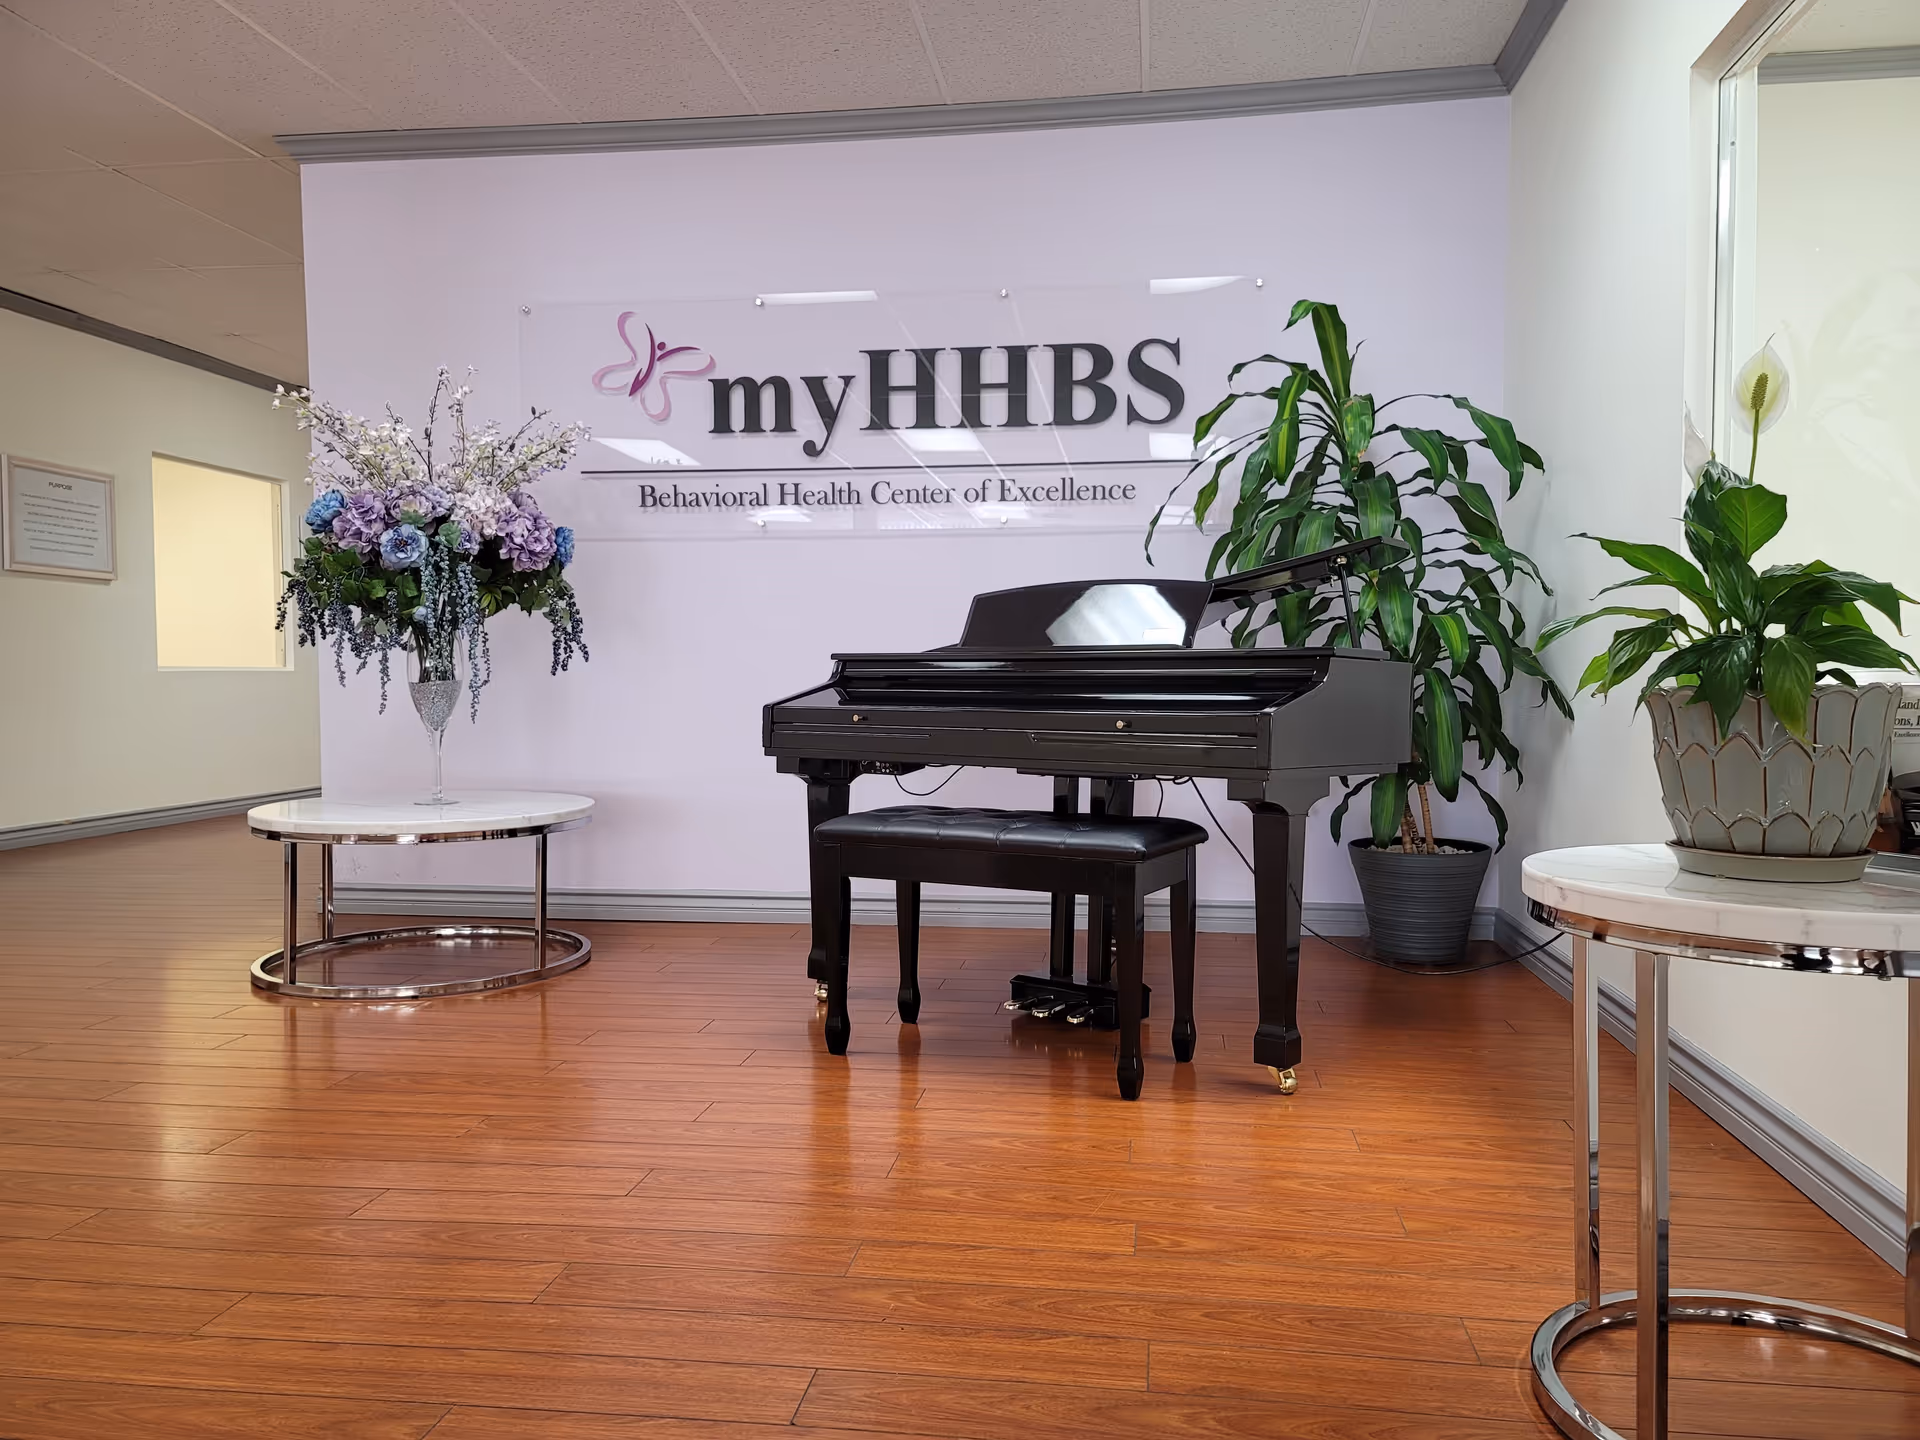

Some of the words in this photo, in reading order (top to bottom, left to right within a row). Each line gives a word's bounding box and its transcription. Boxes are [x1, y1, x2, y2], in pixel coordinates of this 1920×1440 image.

[707, 337, 1186, 458] myHHBS
[48, 481, 73, 491] PURPOSE
[638, 482, 770, 508] Behavioral
[777, 481, 862, 507] Health
[870, 480, 956, 505] Center
[963, 478, 992, 503] of
[997, 477, 1137, 503] Excellence
